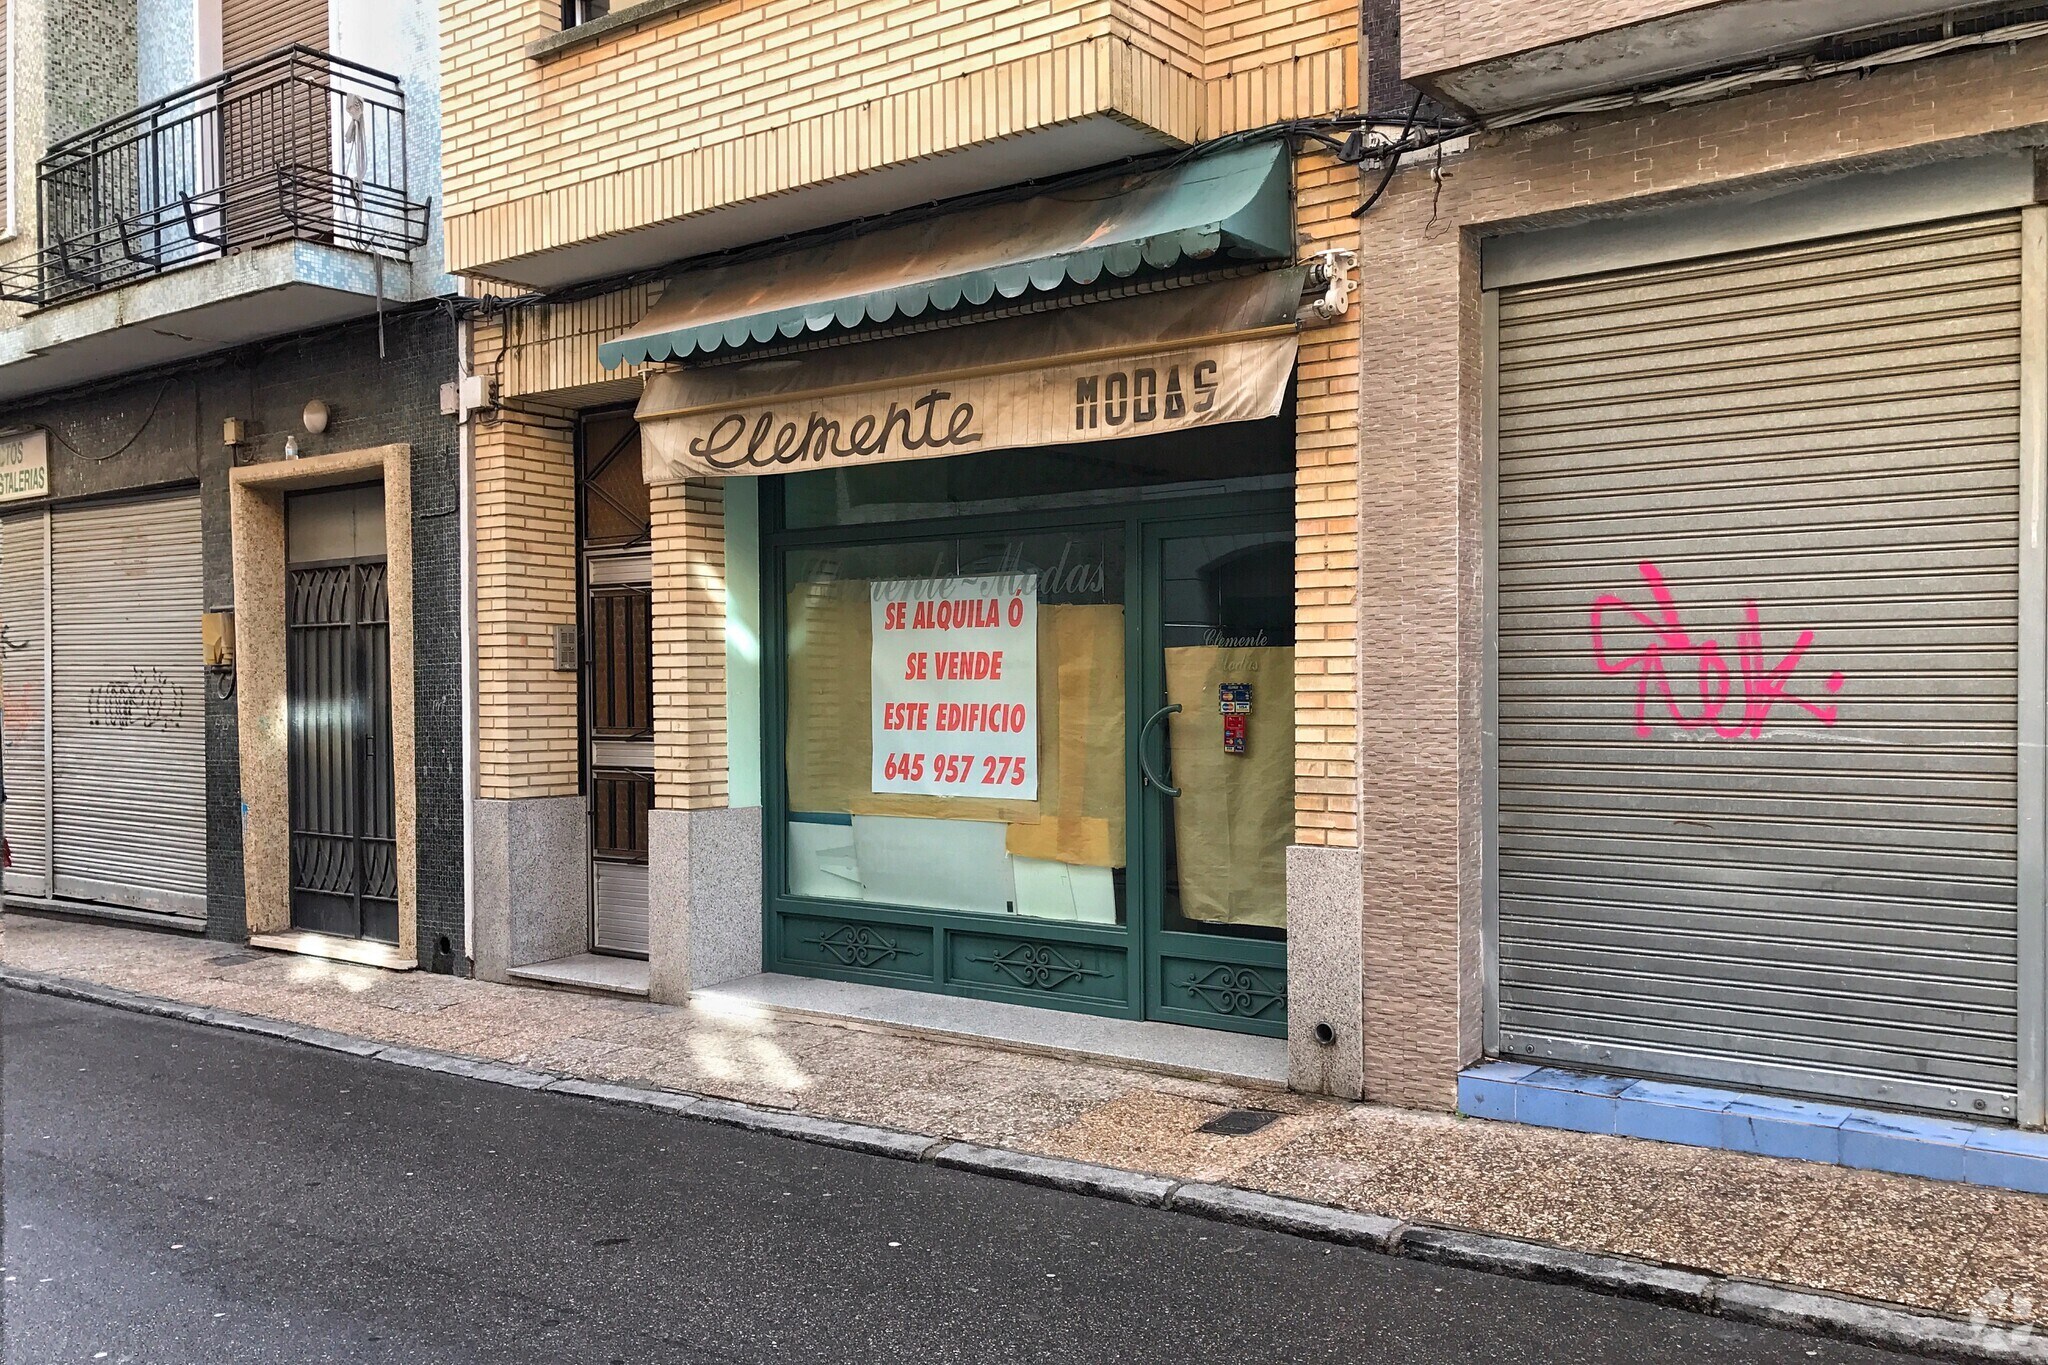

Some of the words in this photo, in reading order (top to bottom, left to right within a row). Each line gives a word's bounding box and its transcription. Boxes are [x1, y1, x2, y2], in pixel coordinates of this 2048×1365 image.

[688, 388, 983, 469] Clemente
[1076, 360, 1218, 430] MODAS
[884, 602, 907, 630] SE
[912, 599, 1000, 631] ALQUILA
[1008, 589, 1024, 627] Ó
[1203, 628, 1268, 647] Clemente
[905, 652, 928, 680] SE
[935, 651, 1003, 680] VENDE
[884, 702, 929, 731] ESTE
[936, 703, 1026, 733] EDIFICIO
[885, 753, 925, 781] 645
[934, 754, 975, 783] 957
[981, 756, 1026, 786] 275
